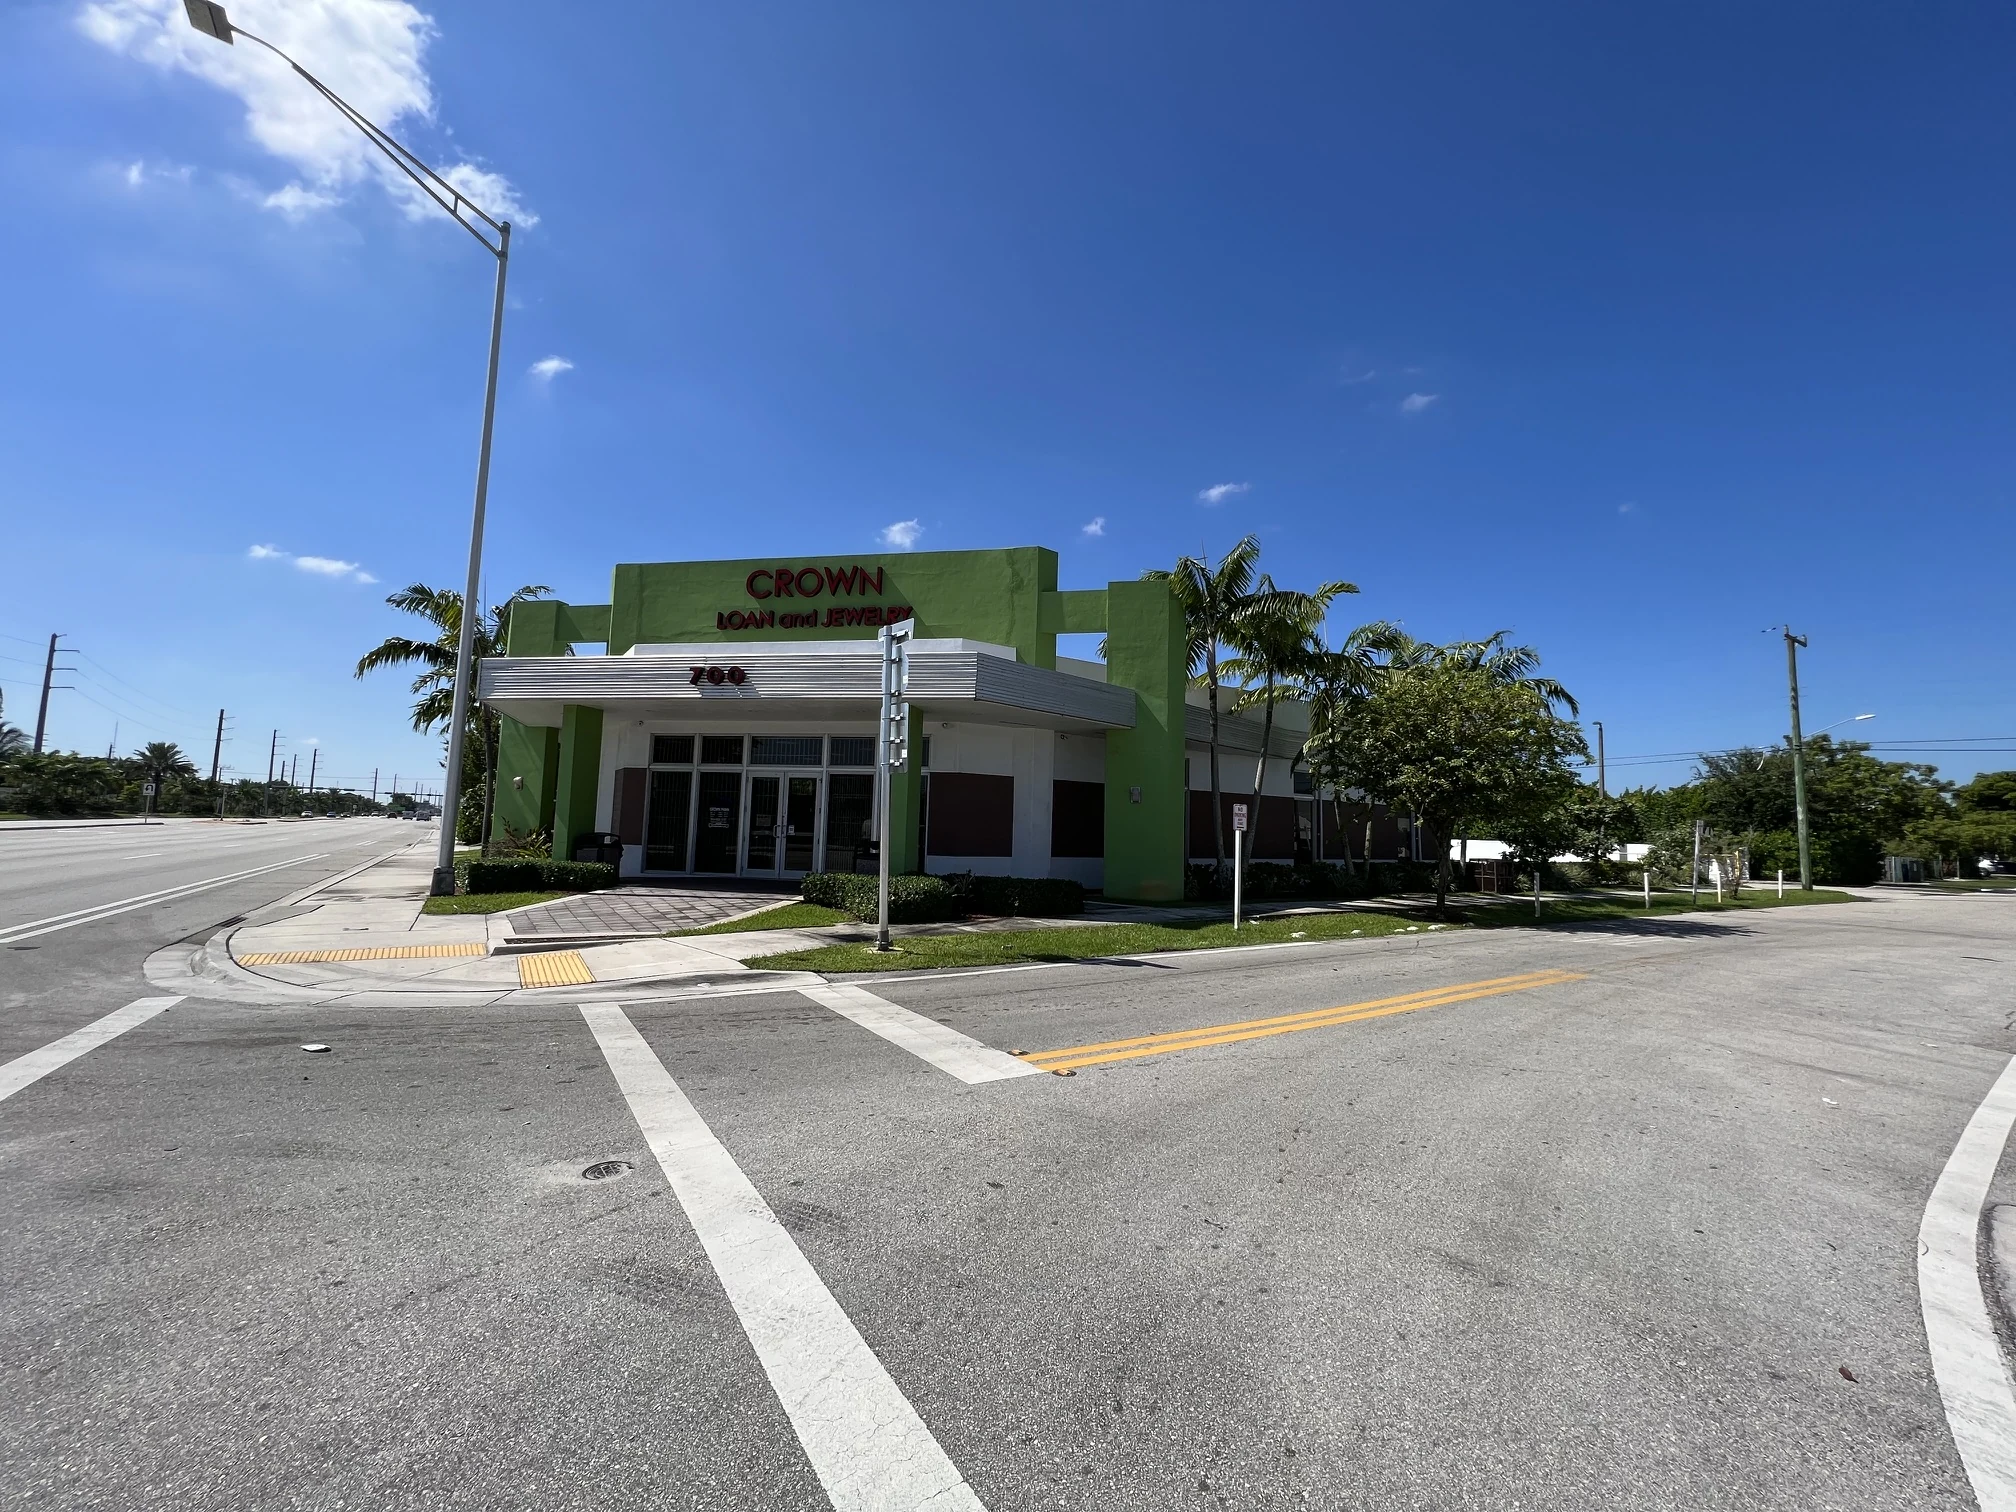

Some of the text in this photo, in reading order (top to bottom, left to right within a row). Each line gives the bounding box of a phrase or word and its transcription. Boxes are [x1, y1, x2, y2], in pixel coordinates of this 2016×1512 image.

[746, 565, 884, 600] CROWN
[717, 606, 912, 630] LOAN and JEWELRY
[689, 666, 746, 685] 700
